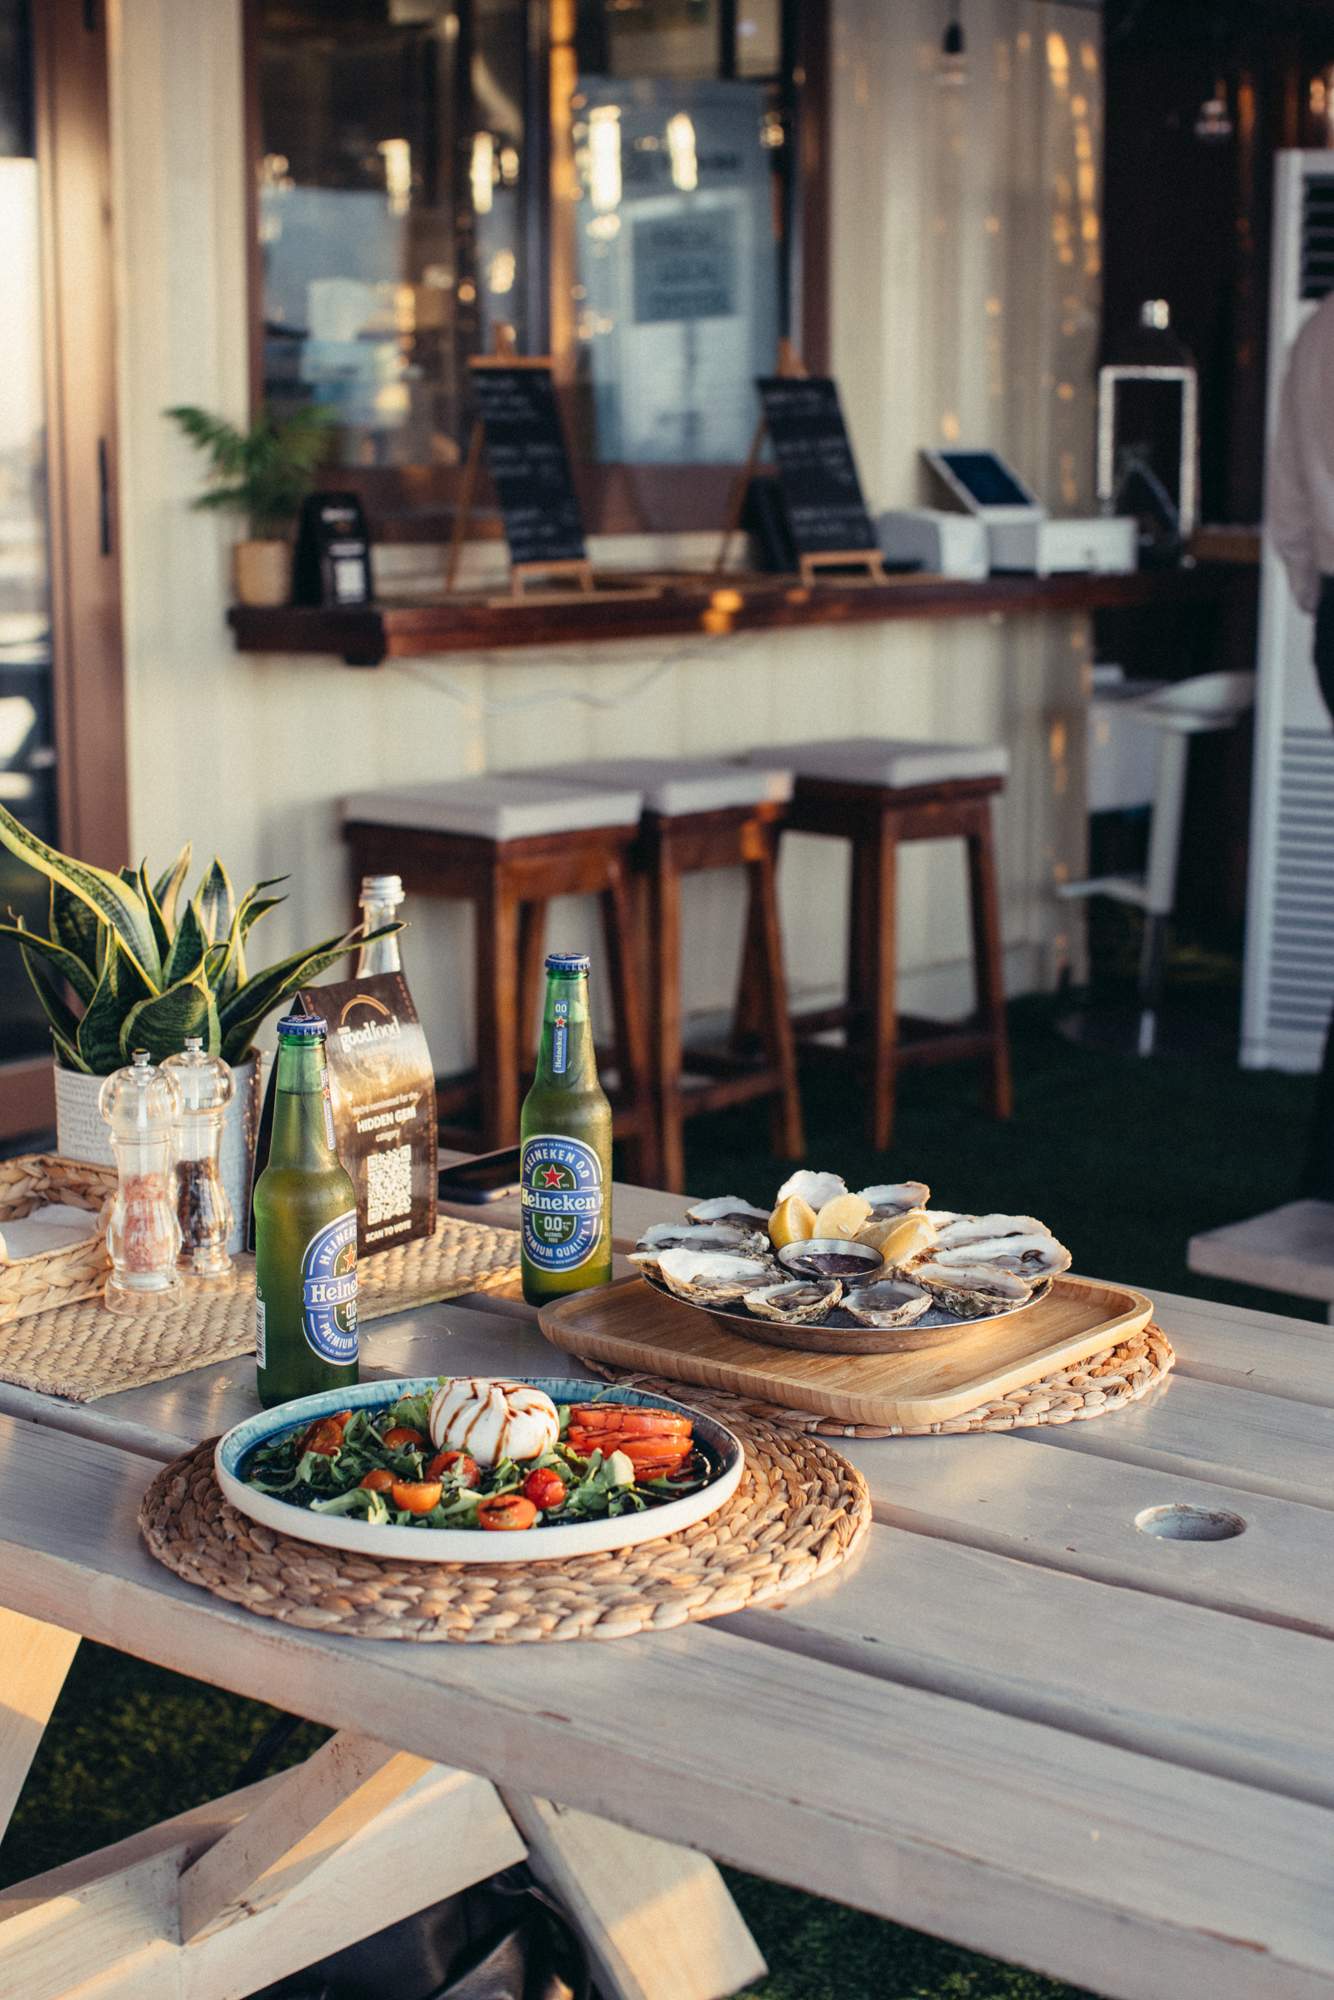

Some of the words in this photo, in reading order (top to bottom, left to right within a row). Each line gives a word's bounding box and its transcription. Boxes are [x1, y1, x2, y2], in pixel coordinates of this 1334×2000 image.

[340, 1015, 401, 1053] goodfood
[356, 1111, 394, 1134] HIDDEN
[394, 1104, 417, 1123] GEM
[575, 1160, 590, 1179] 0.0
[522, 1188, 597, 1211] Heineken
[365, 1228, 384, 1244] SCAN
[383, 1225, 394, 1237] TO
[393, 1219, 412, 1234] VOTE
[525, 1224, 553, 1257] PREMIUM
[556, 1228, 590, 1258] QUALITY
[320, 1322, 353, 1349] PREMIUM
